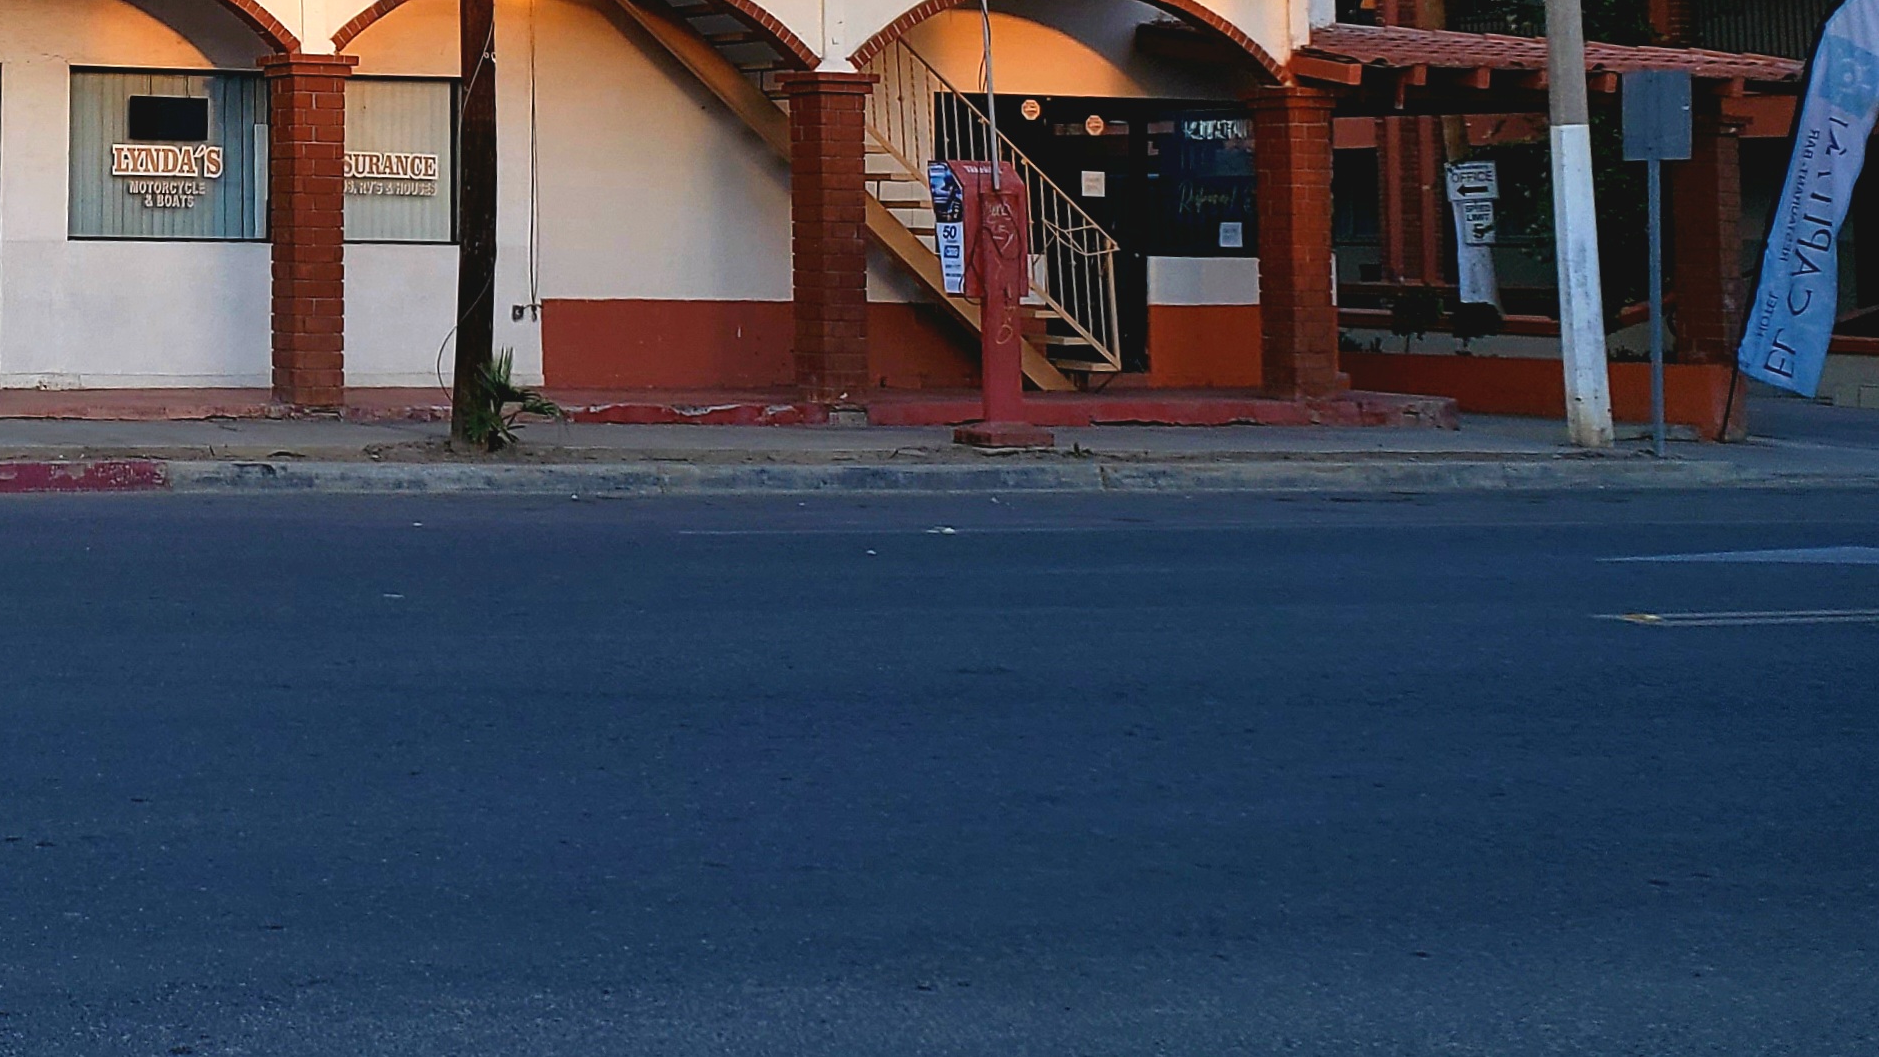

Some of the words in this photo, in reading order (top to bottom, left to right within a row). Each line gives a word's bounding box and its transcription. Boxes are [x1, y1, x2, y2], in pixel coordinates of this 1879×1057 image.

[113, 144, 223, 178] LYNDA'S
[344, 151, 438, 180] SURANCE
[129, 181, 206, 195] MOTORCYCLE
[145, 195, 154, 207] &
[157, 195, 195, 208] BOATS
[943, 226, 957, 239] 50
